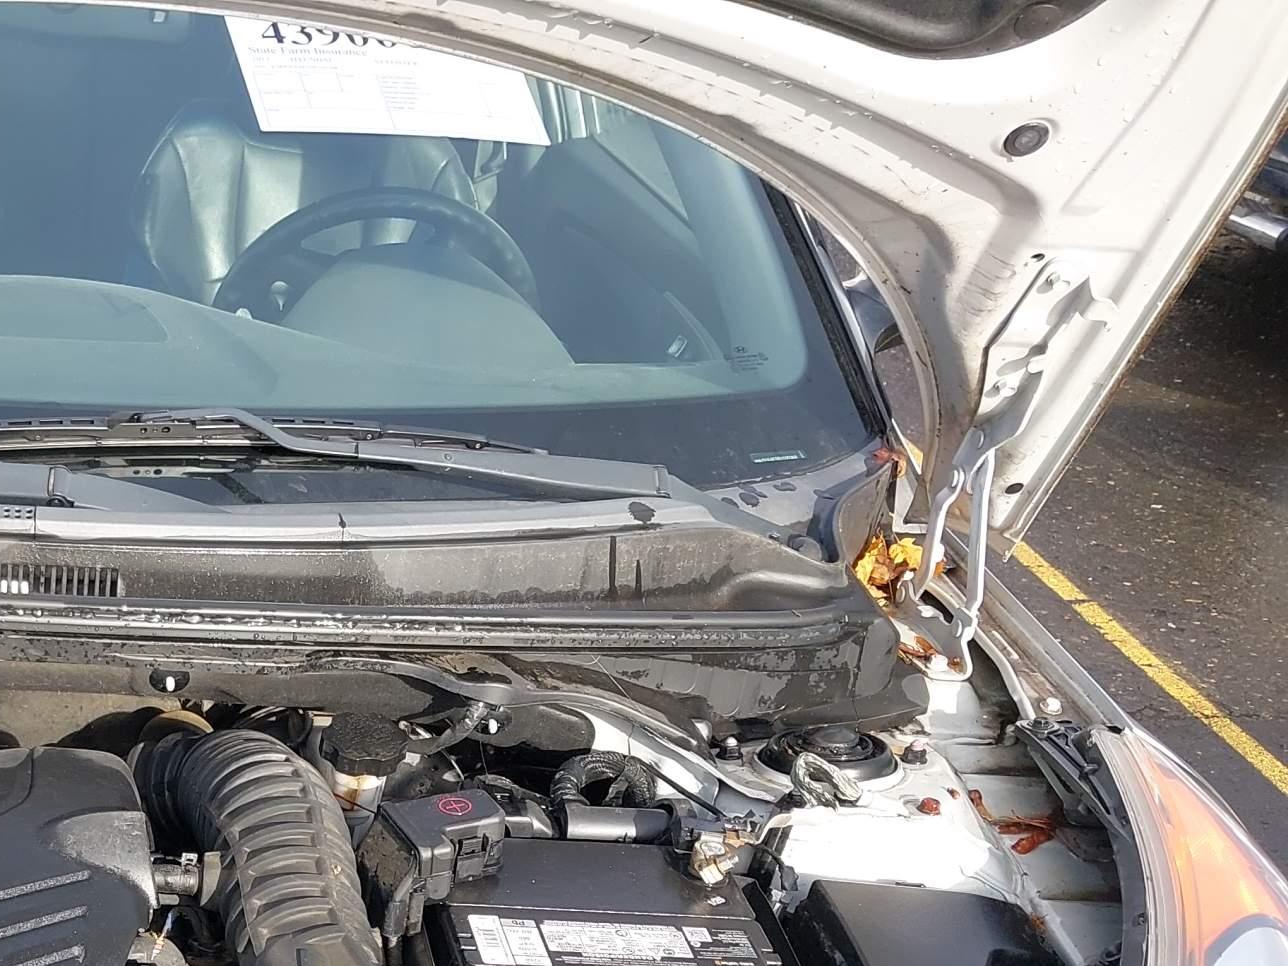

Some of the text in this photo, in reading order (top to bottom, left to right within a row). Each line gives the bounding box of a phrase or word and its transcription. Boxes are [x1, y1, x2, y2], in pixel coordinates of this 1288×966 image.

[248, 47, 368, 57] State Farm Insurance
